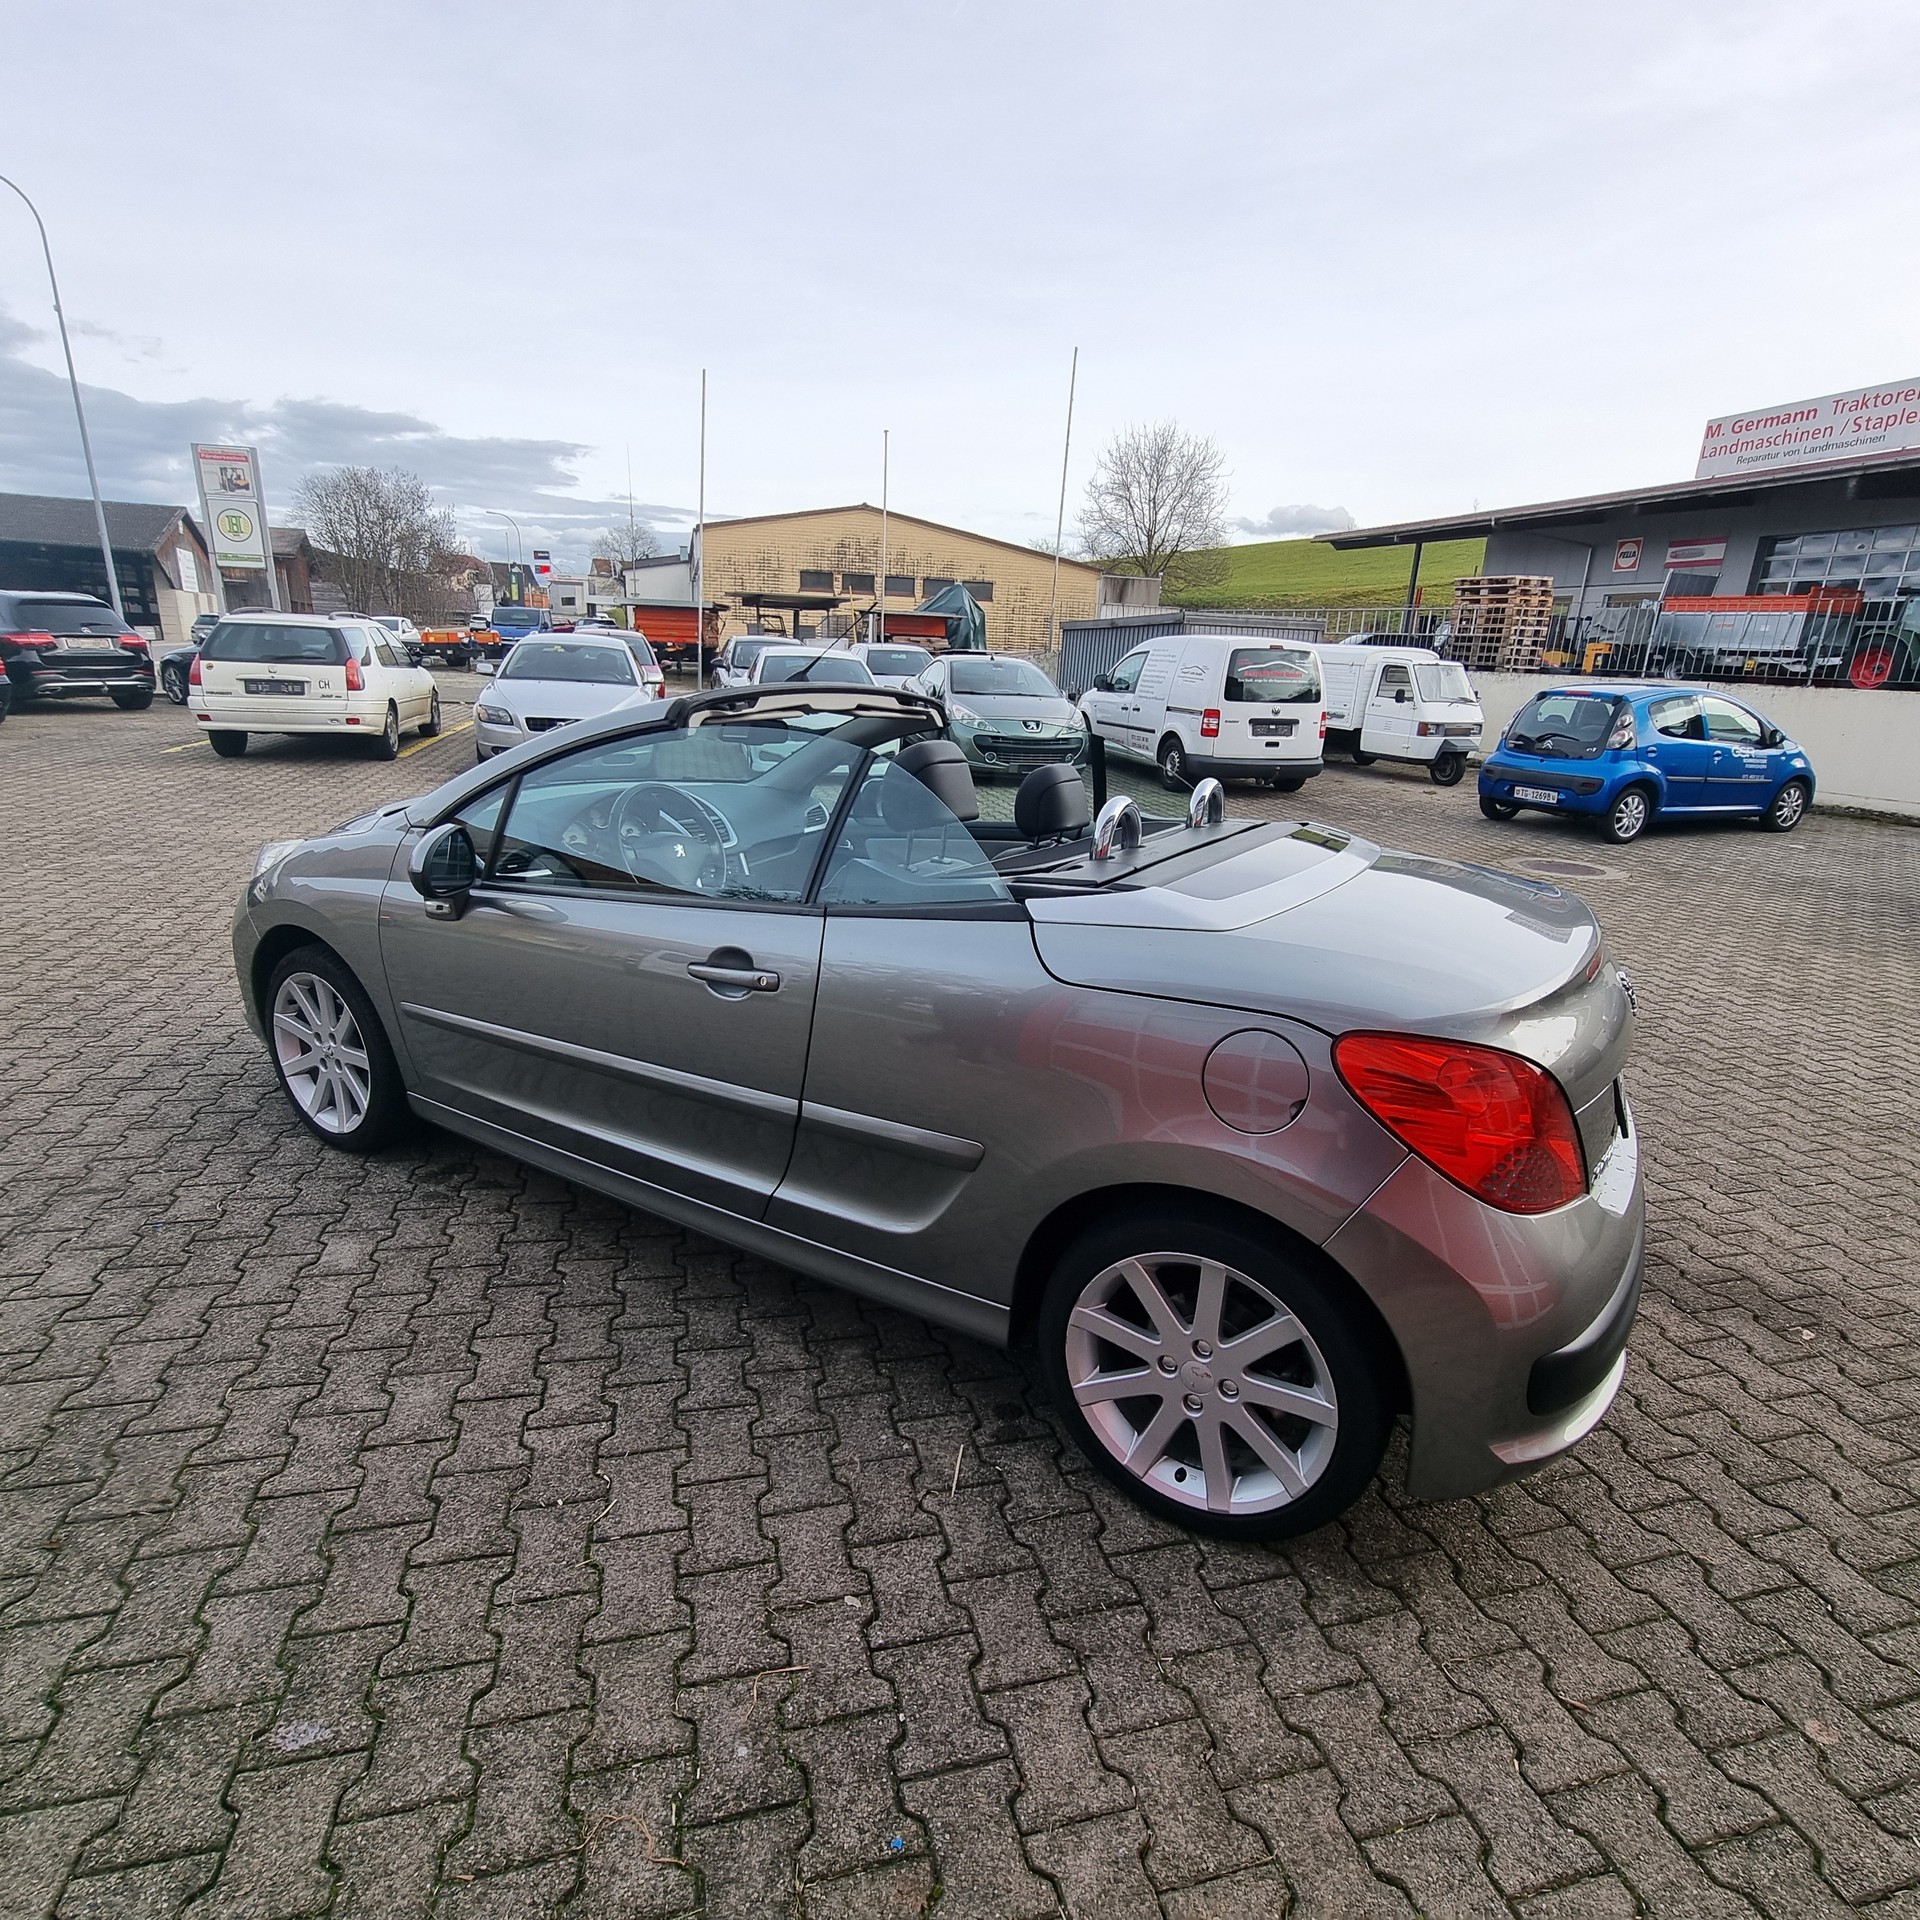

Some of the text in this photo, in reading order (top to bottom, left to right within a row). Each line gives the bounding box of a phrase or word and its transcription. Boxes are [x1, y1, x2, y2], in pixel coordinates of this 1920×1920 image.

[1705, 388, 1920, 439] M. Germann Traktore
[1701, 425, 1834, 459] Landmaschinen
[1851, 407, 1920, 433] Staple
[1736, 434, 1886, 465] Reparatur von Landmaschinen
[1619, 550, 1637, 559] FELLA
[318, 680, 331, 690] CH
